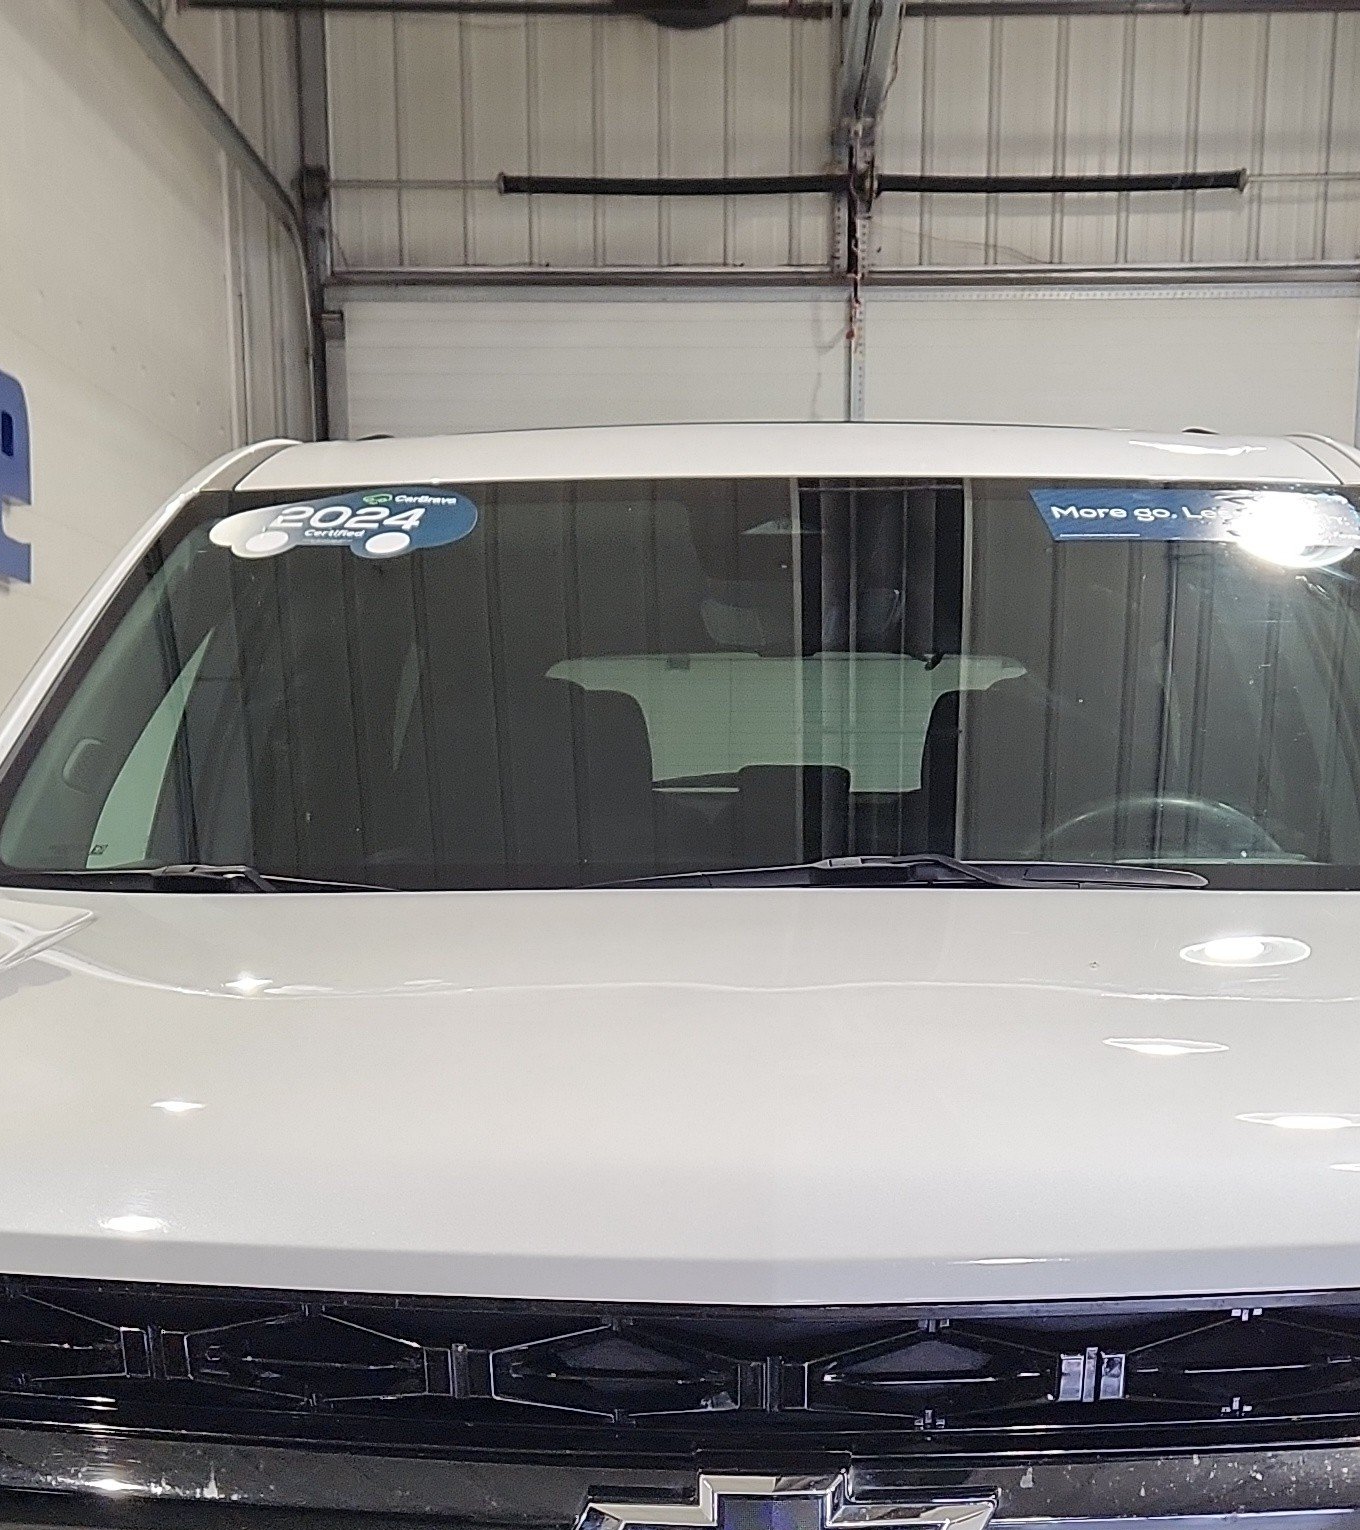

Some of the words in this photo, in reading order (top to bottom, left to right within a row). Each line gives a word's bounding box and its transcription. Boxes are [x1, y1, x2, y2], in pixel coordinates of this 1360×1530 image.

[269, 505, 426, 531] 2024
[1050, 505, 1127, 520] More
[1133, 507, 1178, 522] go.
[304, 529, 365, 538] Certified
